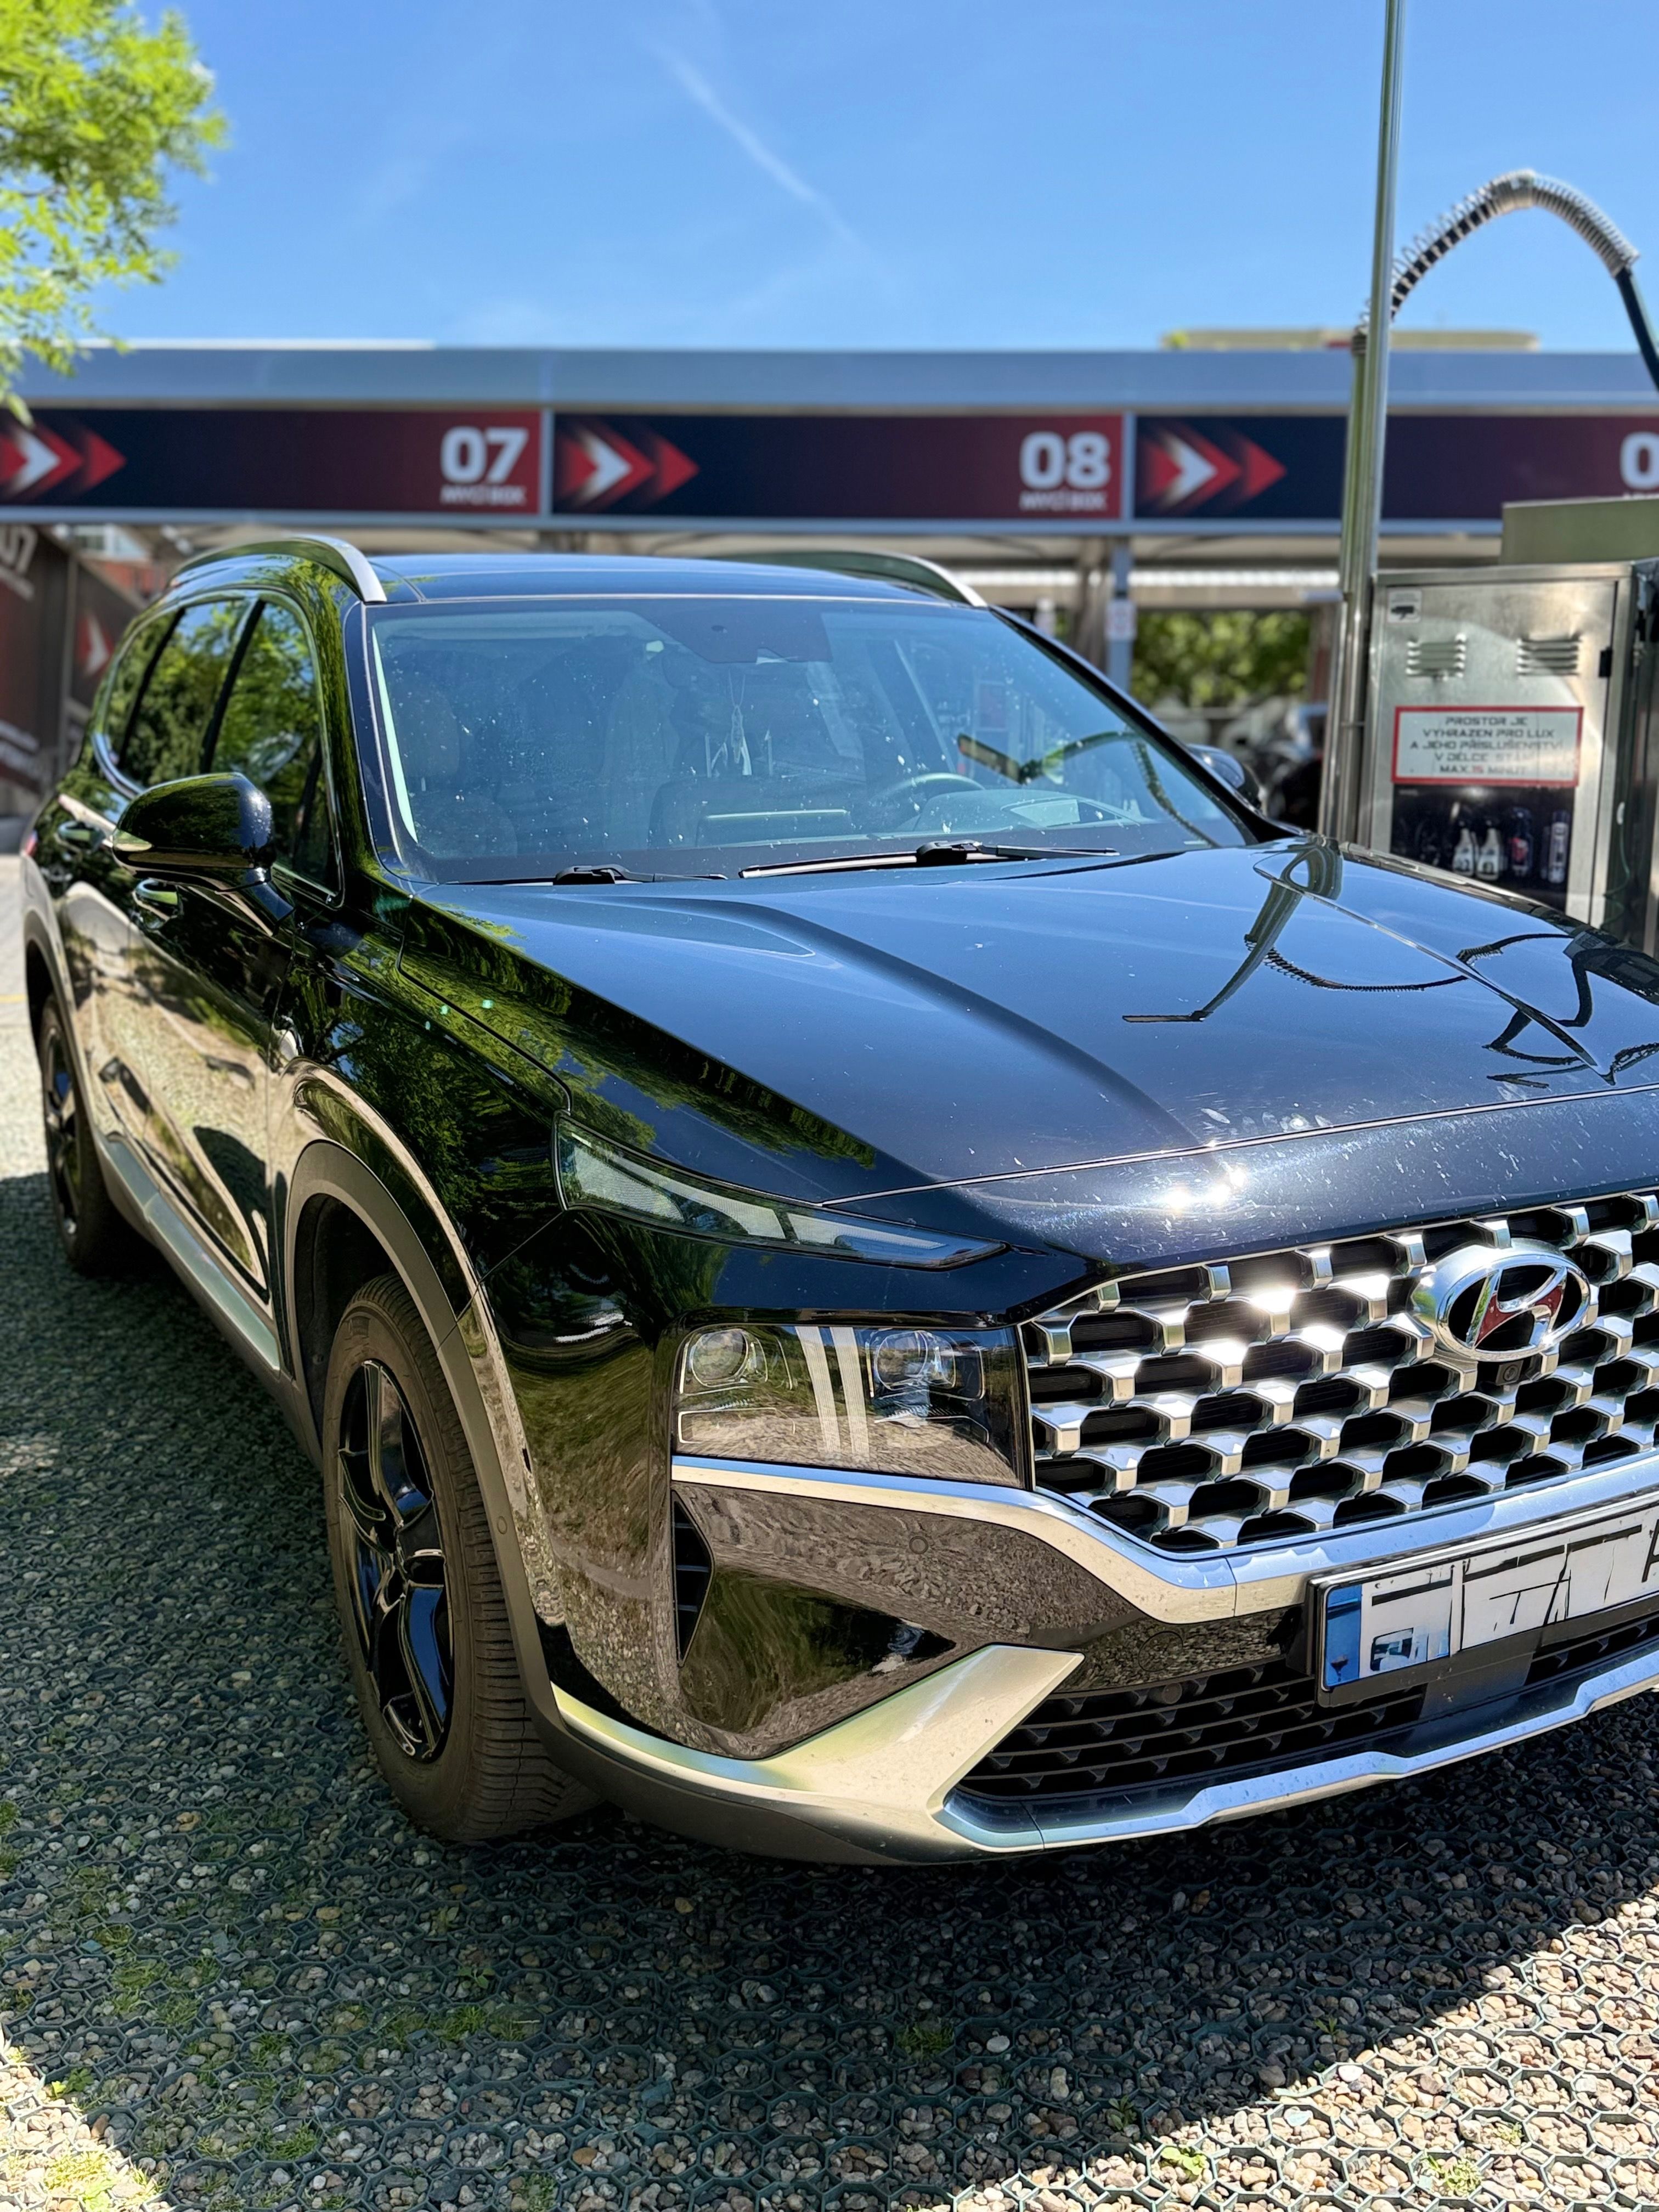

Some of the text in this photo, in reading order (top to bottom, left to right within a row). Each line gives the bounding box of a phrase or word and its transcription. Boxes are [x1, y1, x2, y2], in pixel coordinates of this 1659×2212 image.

[441, 426, 529, 483] 07
[1019, 431, 1111, 489] 08
[1446, 716, 1528, 726] PROSTOR JE
[1423, 729, 1555, 738] VYHRAZEN PRO LUX
[1410, 741, 1418, 749] A
[1423, 741, 1457, 750] JEHO
[1435, 752, 1443, 761] V
